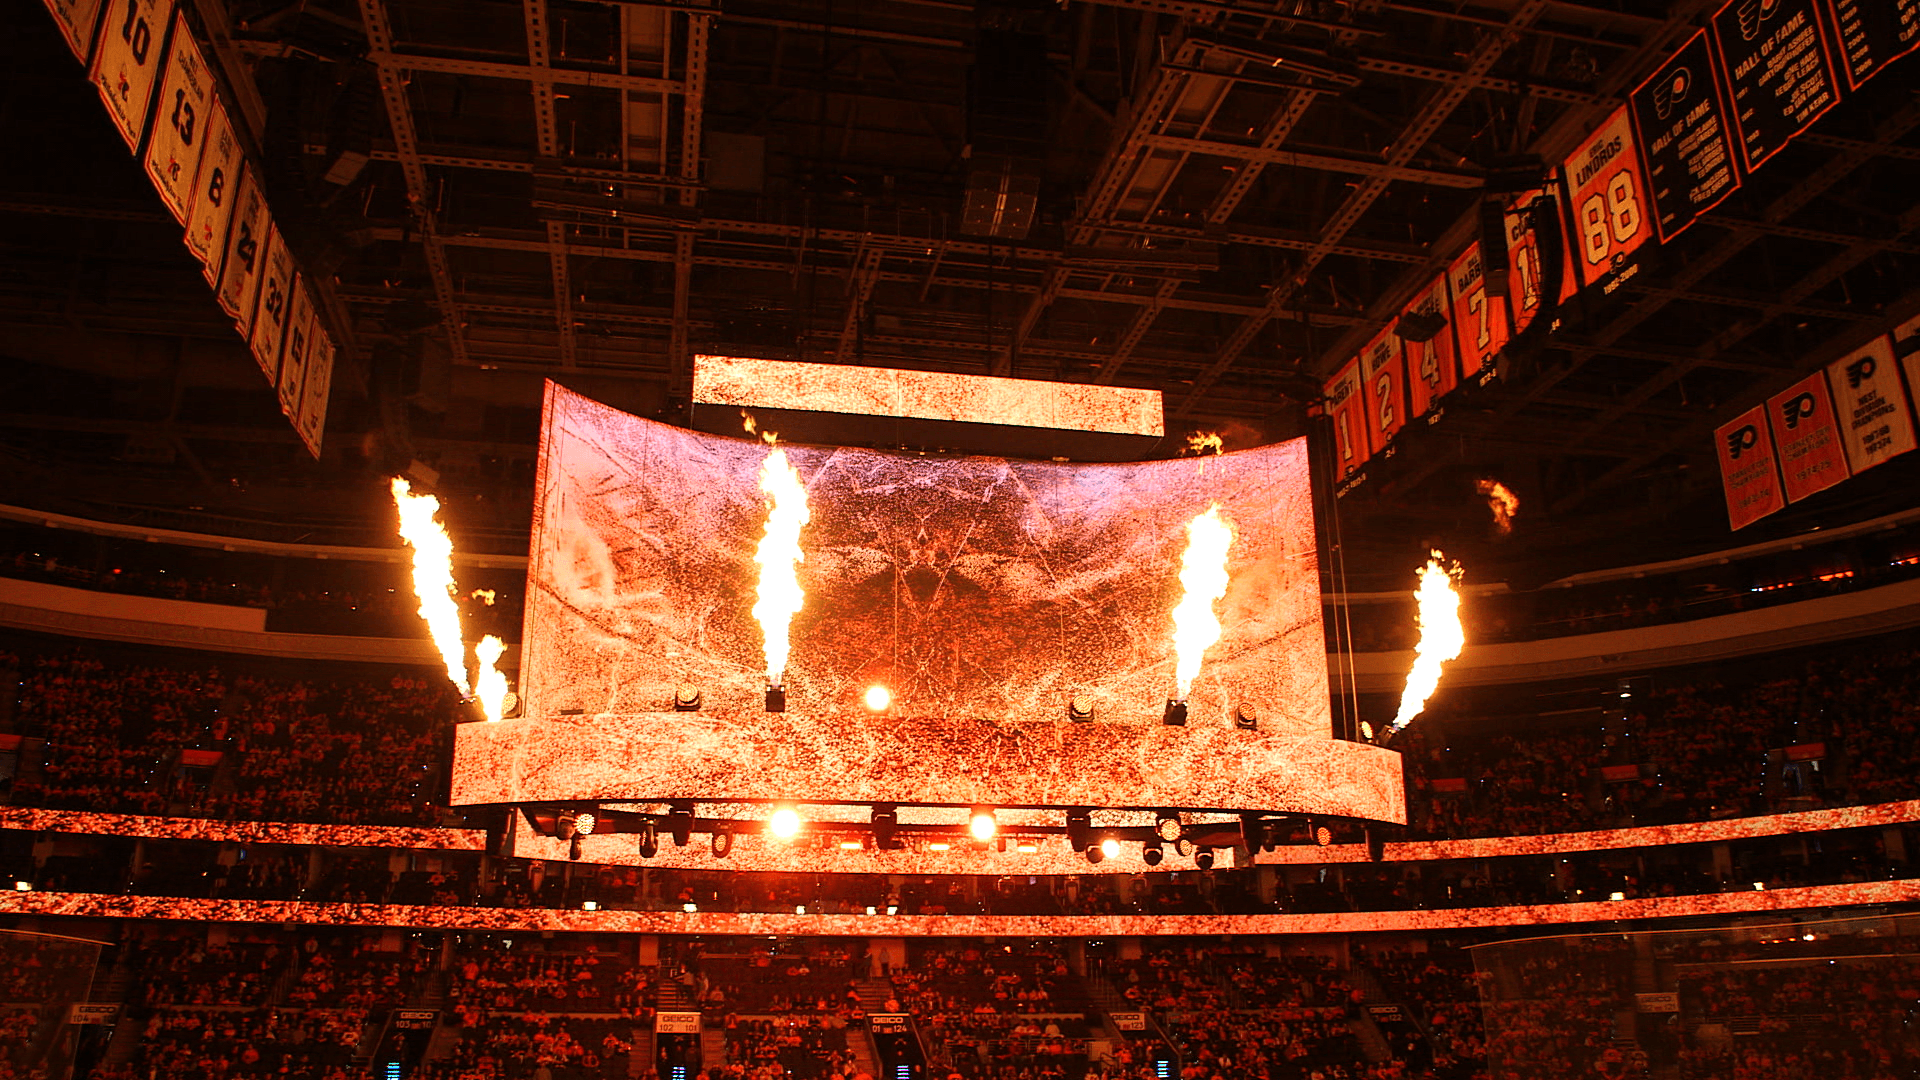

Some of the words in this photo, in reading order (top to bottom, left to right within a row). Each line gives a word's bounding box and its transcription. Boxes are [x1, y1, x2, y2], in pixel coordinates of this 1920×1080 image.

[122, 0, 151, 66] 10
[1734, 51, 1761, 81] HALL
[1760, 36, 1775, 57] OF
[1775, 10, 1806, 44] FAME
[171, 88, 195, 146] 13
[1651, 130, 1673, 157] HALL
[1671, 119, 1684, 137] OF
[1685, 98, 1711, 128] FAME
[1576, 136, 1622, 186] LINDROS
[1589, 139, 1603, 158] ERIC
[1581, 168, 1641, 266] 88
[237, 221, 258, 276] 24
[266, 277, 283, 328] 32
[1458, 263, 1481, 294] BARB
[1469, 286, 1490, 351] 7
[1421, 339, 1440, 389] 4
[1377, 372, 1393, 431] 2
[1340, 408, 1352, 461] 1
[395, 1020, 411, 1028] 103
[421, 1021, 434, 1029] 10
[400, 1012, 434, 1020] GEICO
[662, 1015, 694, 1023] GEICO
[872, 1016, 904, 1024] GEICO
[872, 1025, 881, 1033] 01
[893, 1024, 907, 1032] 124
[1369, 1006, 1398, 1014] GEICO
